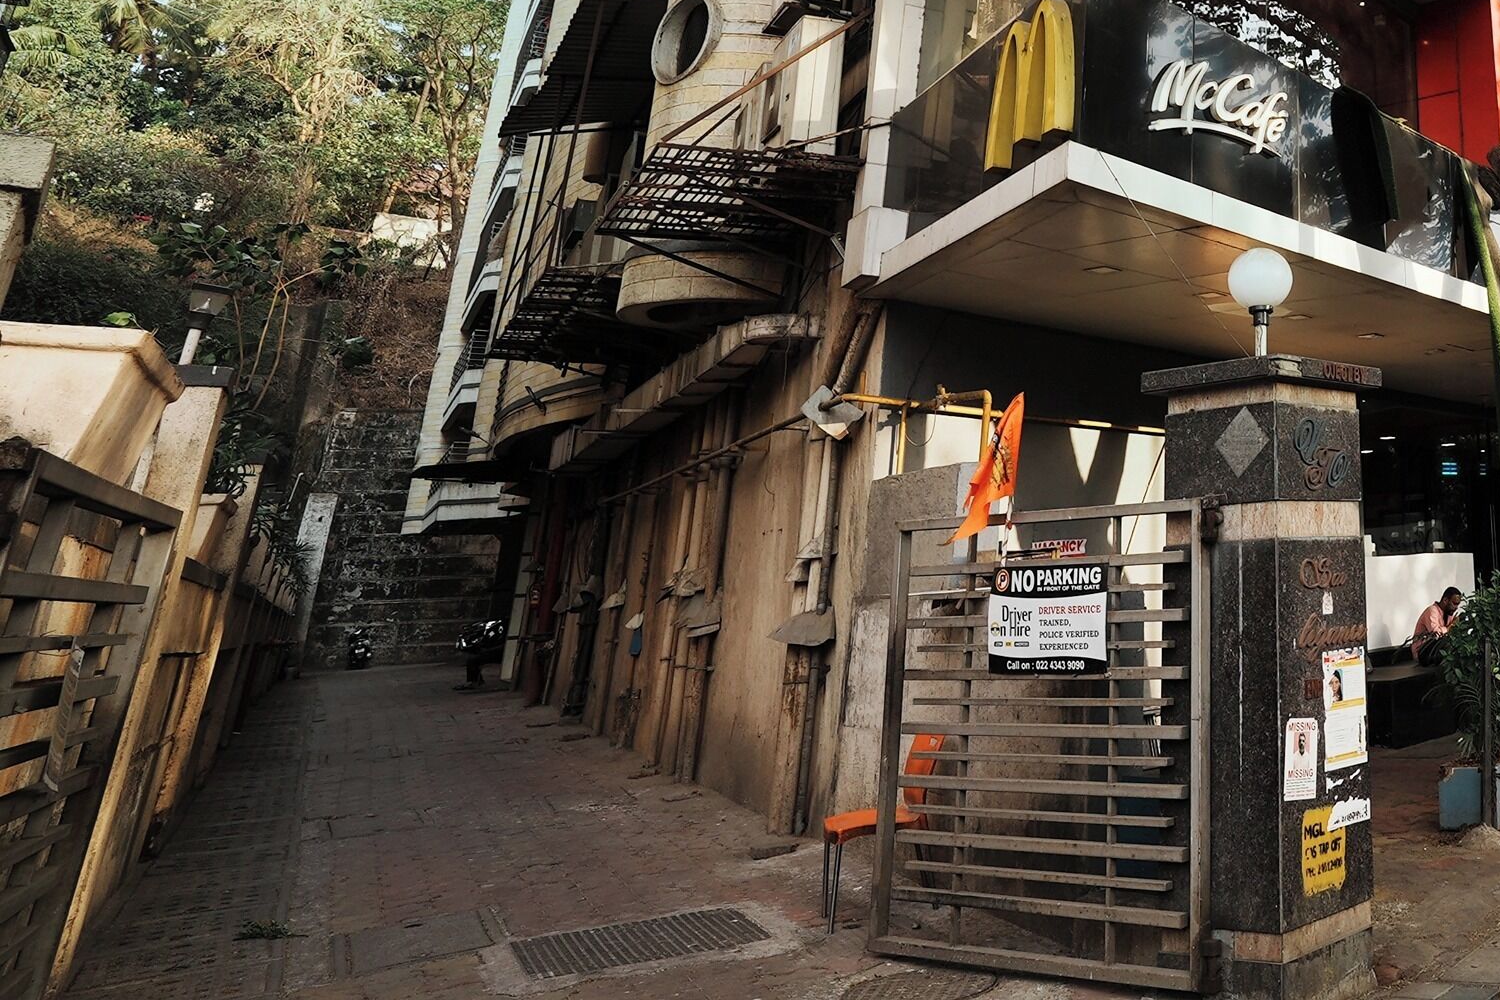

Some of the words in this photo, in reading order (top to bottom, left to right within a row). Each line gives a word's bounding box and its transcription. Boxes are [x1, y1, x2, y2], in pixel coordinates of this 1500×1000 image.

[1011, 570, 1035, 592] NO
[1037, 567, 1102, 586] PARKING
[1002, 605, 1032, 622] Driver
[1038, 606, 1066, 615] DRIVER
[1068, 605, 1101, 614] SERVICE
[1039, 619, 1071, 627] TRAINED,
[1009, 621, 1031, 637] Hire
[1065, 630, 1099, 638] VERIFIED
[1039, 642, 1088, 650] EXPERIENCED
[1007, 660, 1020, 670] Call
[1021, 662, 1030, 670] on
[1036, 660, 1048, 670] 022
[1050, 660, 1065, 670] 4343
[1067, 660, 1085, 669] 9090
[1288, 721, 1317, 732] MISSING
[1288, 768, 1314, 779] MISSING
[1304, 822, 1325, 840] MGL
